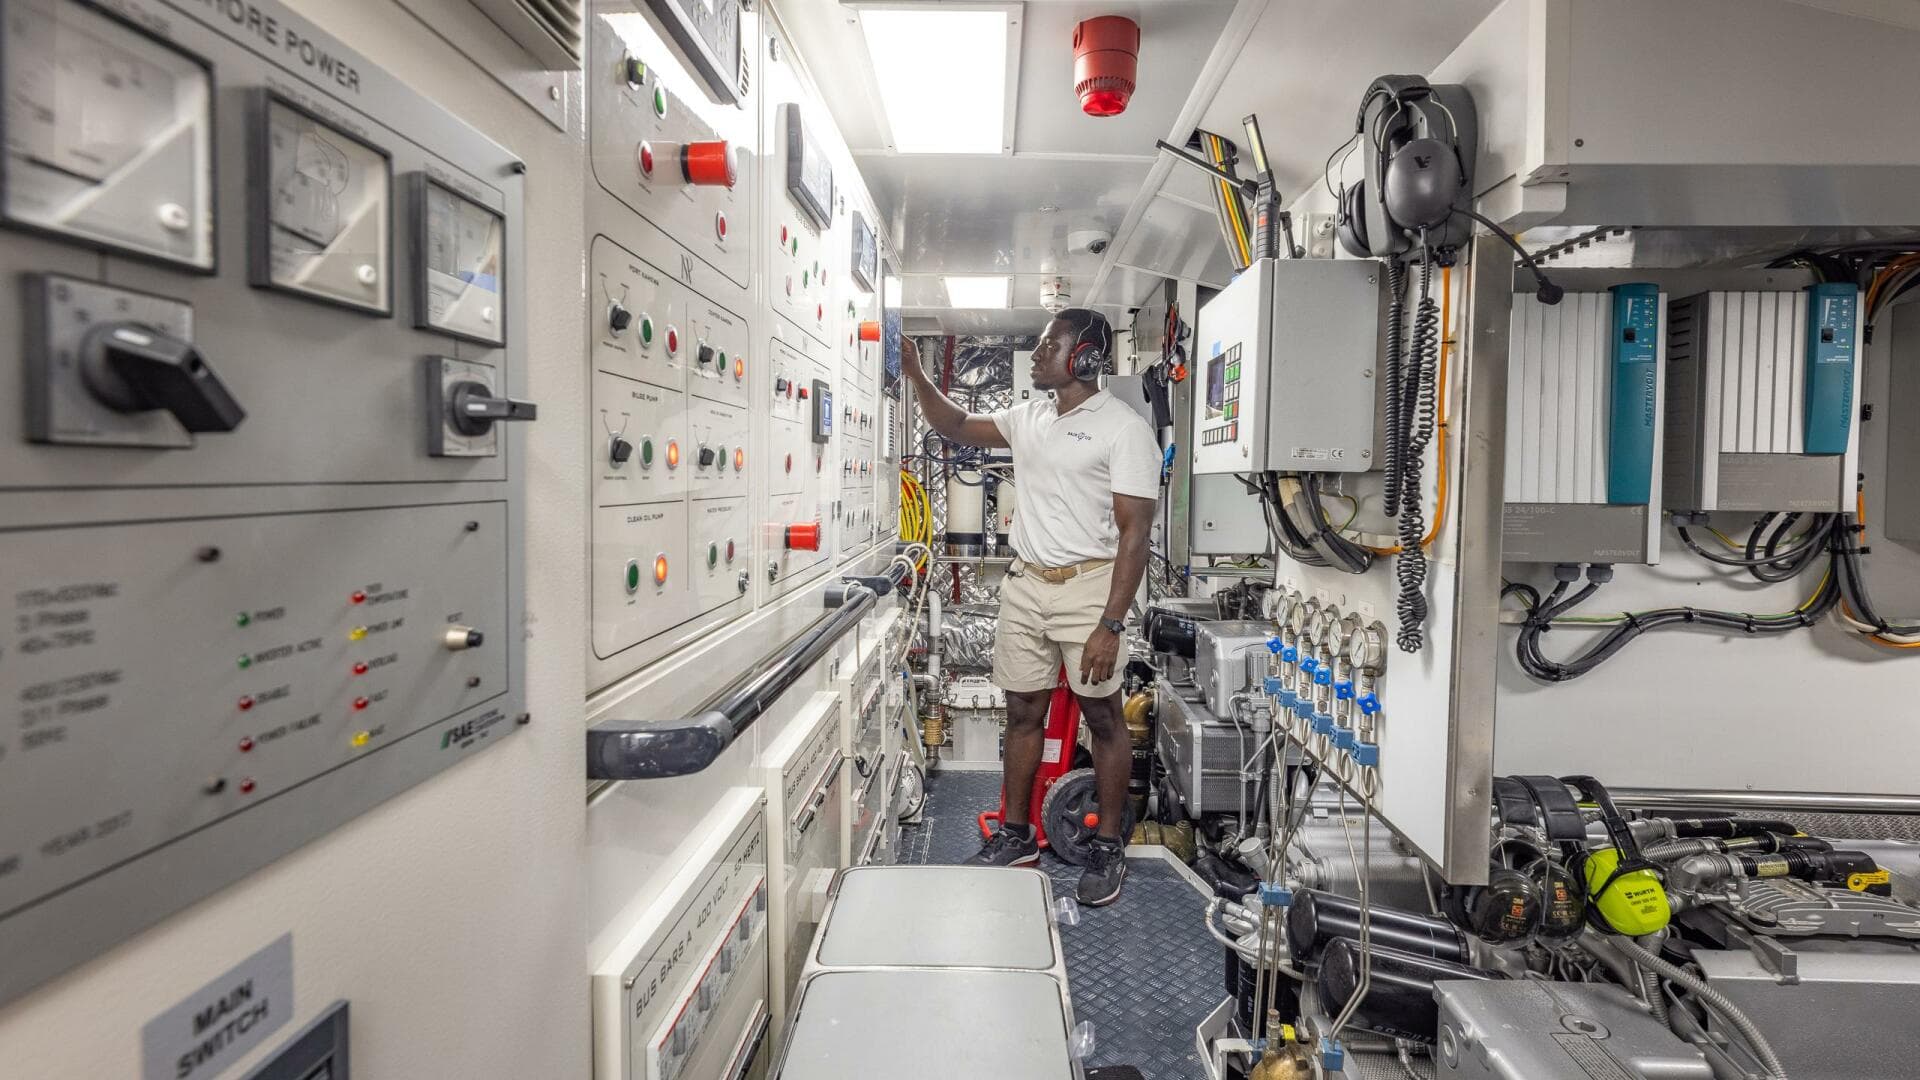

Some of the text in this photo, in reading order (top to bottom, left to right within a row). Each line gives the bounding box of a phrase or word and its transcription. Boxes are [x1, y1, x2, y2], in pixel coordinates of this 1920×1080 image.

[284, 29, 361, 95] POWER
[1643, 369, 1654, 427] MASTERVOLT
[1840, 369, 1852, 431] MASTERVOLT
[627, 512, 664, 524] CLEAN OIL PUMP
[1592, 549, 1641, 558] MASTERVOLT
[635, 978, 657, 1018] BUS
[660, 940, 684, 984] BARS
[685, 929, 693, 946] A
[696, 902, 712, 929] 400
[712, 876, 730, 906] VOLT
[743, 831, 760, 863] HERTZ
[176, 997, 269, 1079] SWITCH
[192, 976, 254, 1038] MAIN
